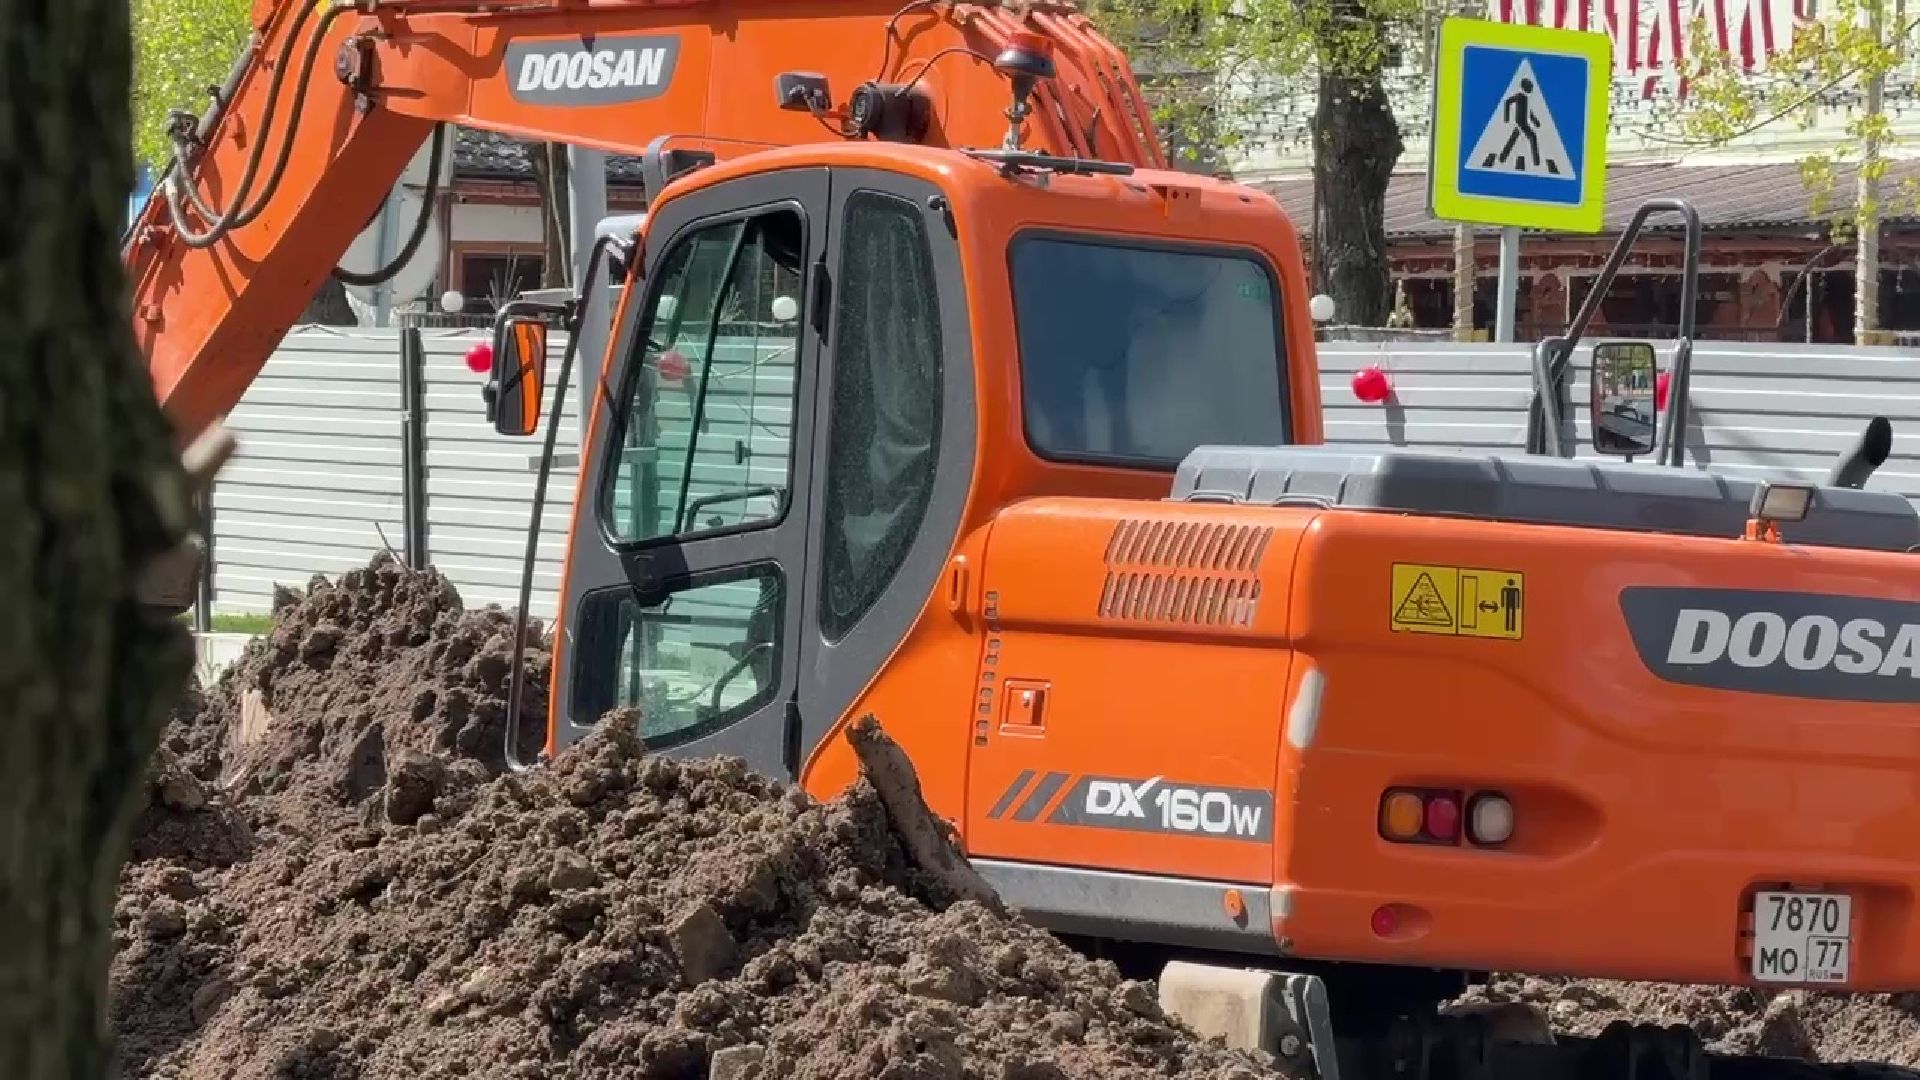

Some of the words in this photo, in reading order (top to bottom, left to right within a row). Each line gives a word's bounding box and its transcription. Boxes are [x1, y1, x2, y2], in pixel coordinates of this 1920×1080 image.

[517, 48, 666, 91] DOOSAN
[1769, 896, 1839, 933] 7870
[1816, 940, 1842, 967] 77
